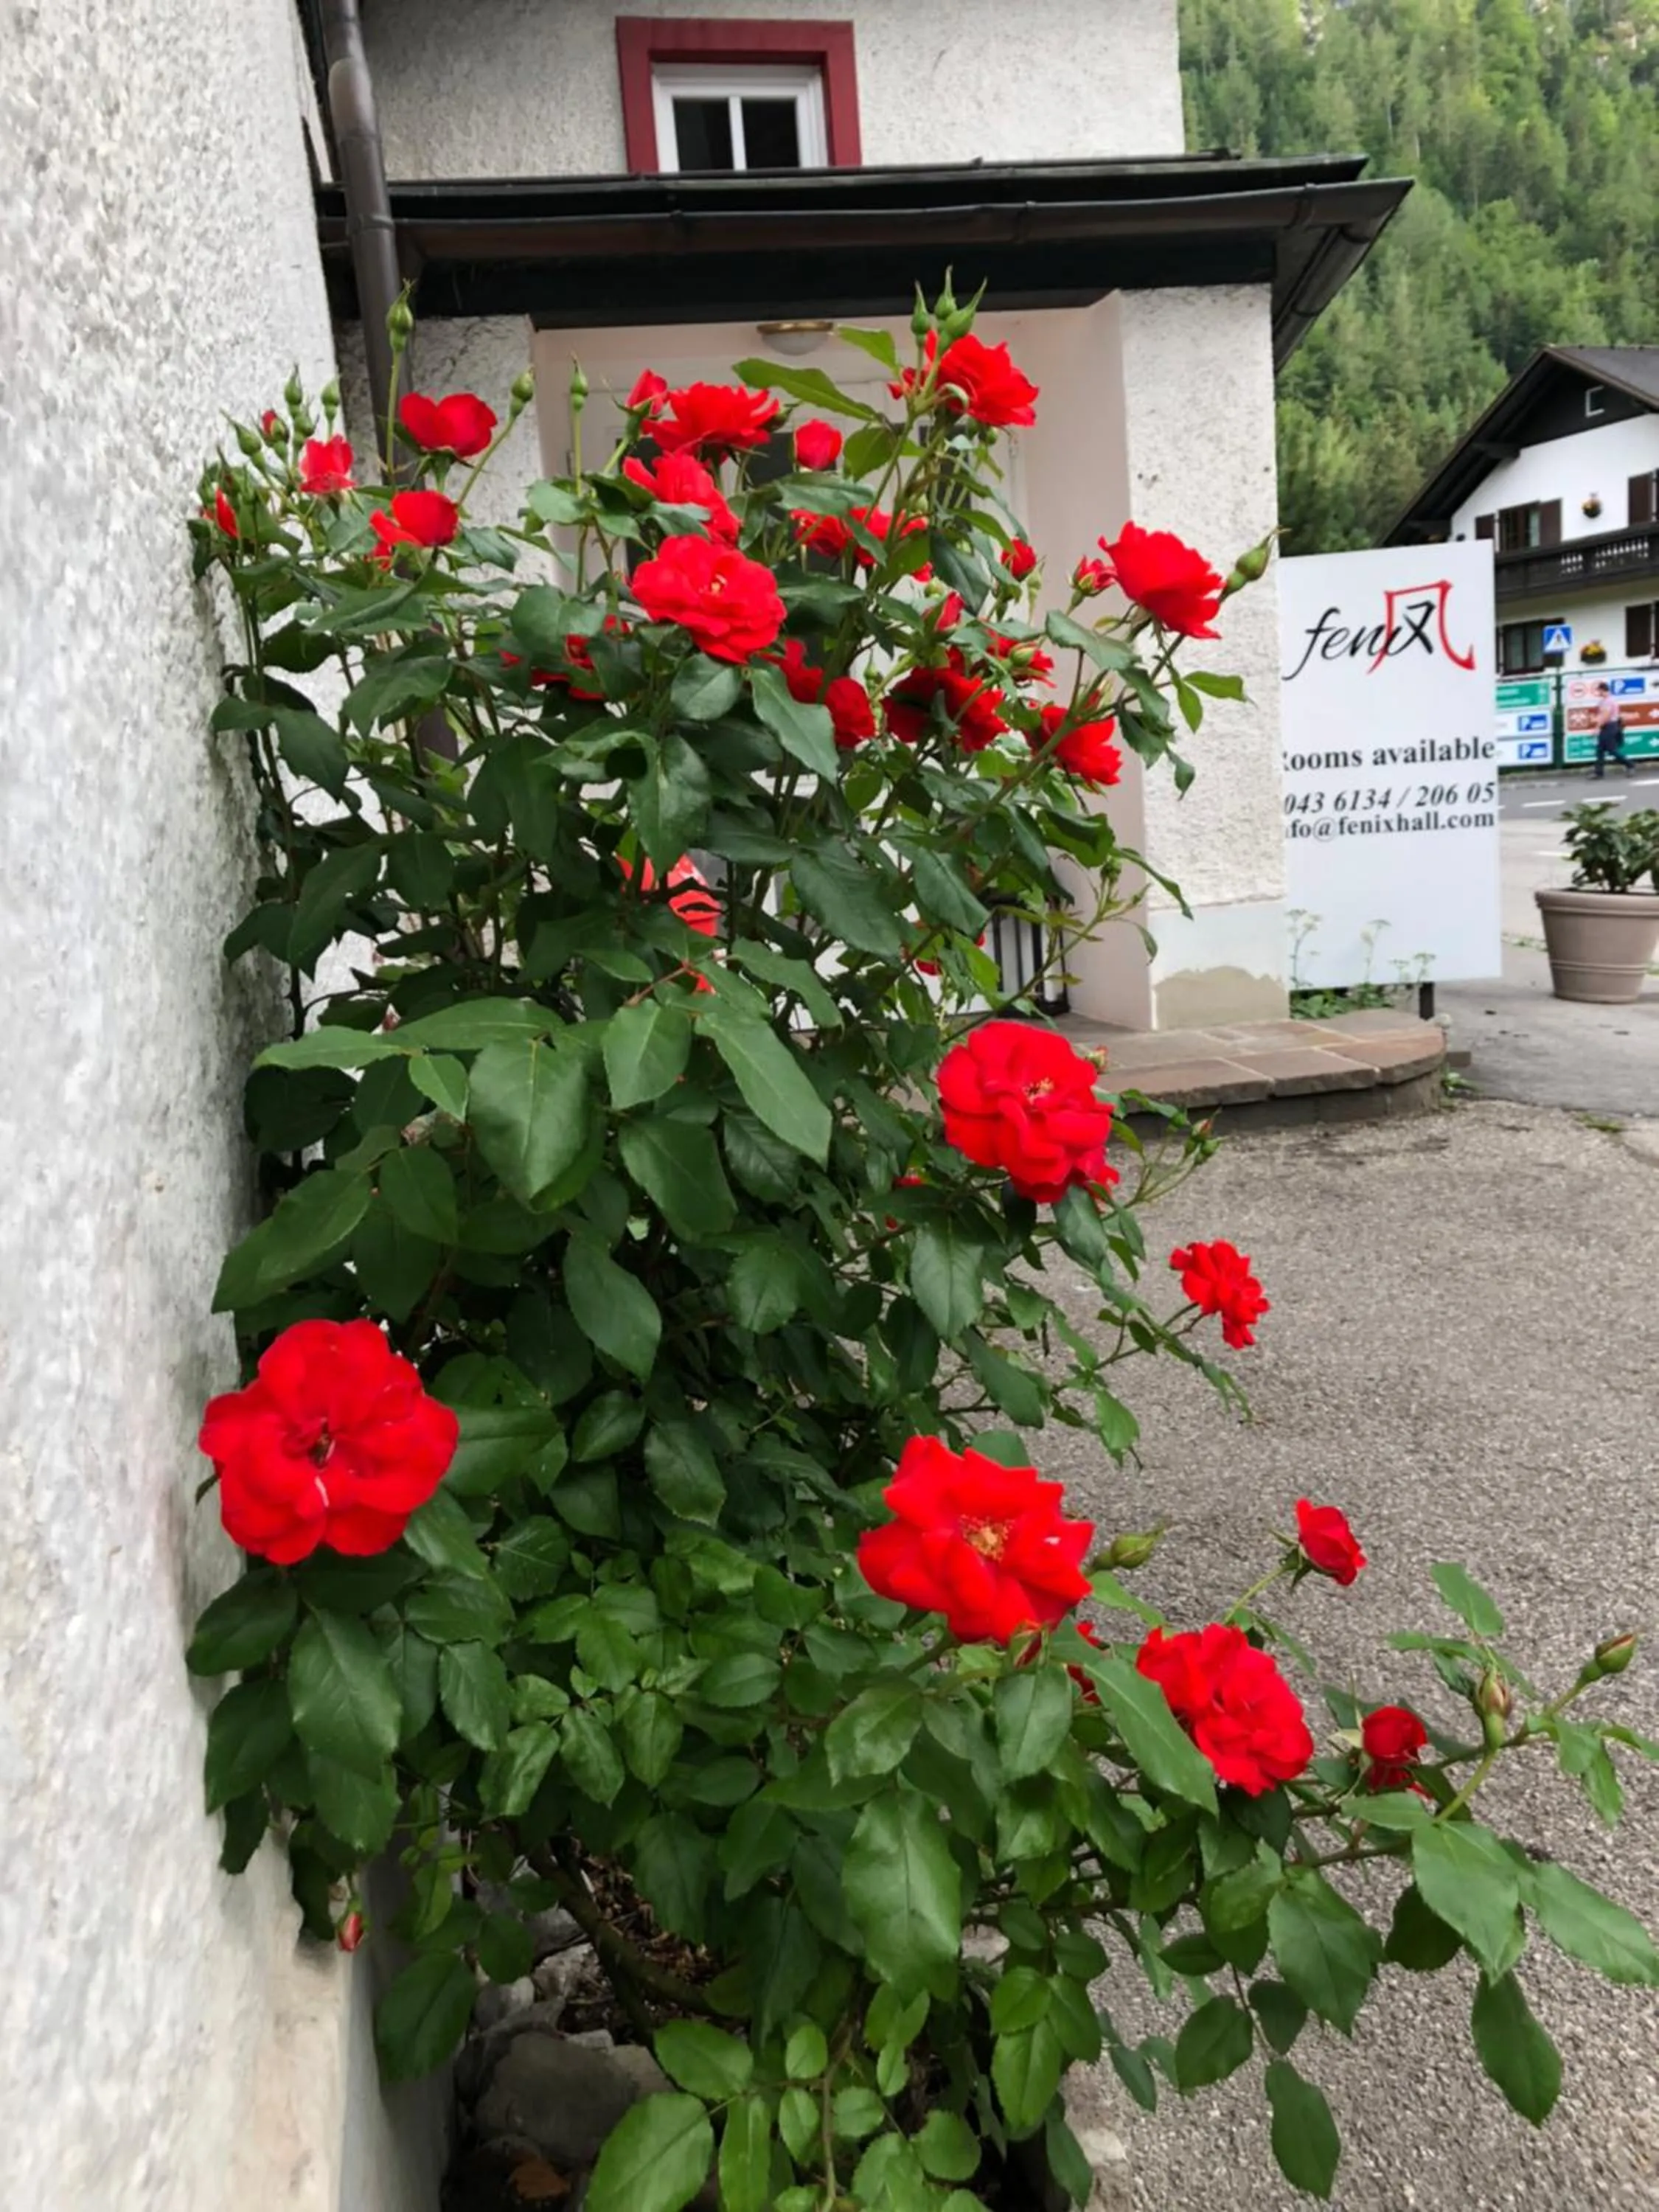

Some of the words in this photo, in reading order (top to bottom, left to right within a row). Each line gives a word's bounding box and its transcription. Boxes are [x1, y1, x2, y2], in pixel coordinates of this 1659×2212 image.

[1372, 736, 1495, 766] available
[1284, 791, 1325, 815] 043
[1333, 787, 1392, 812] 6134
[1415, 783, 1458, 807] 206
[1467, 782, 1495, 804] 05
